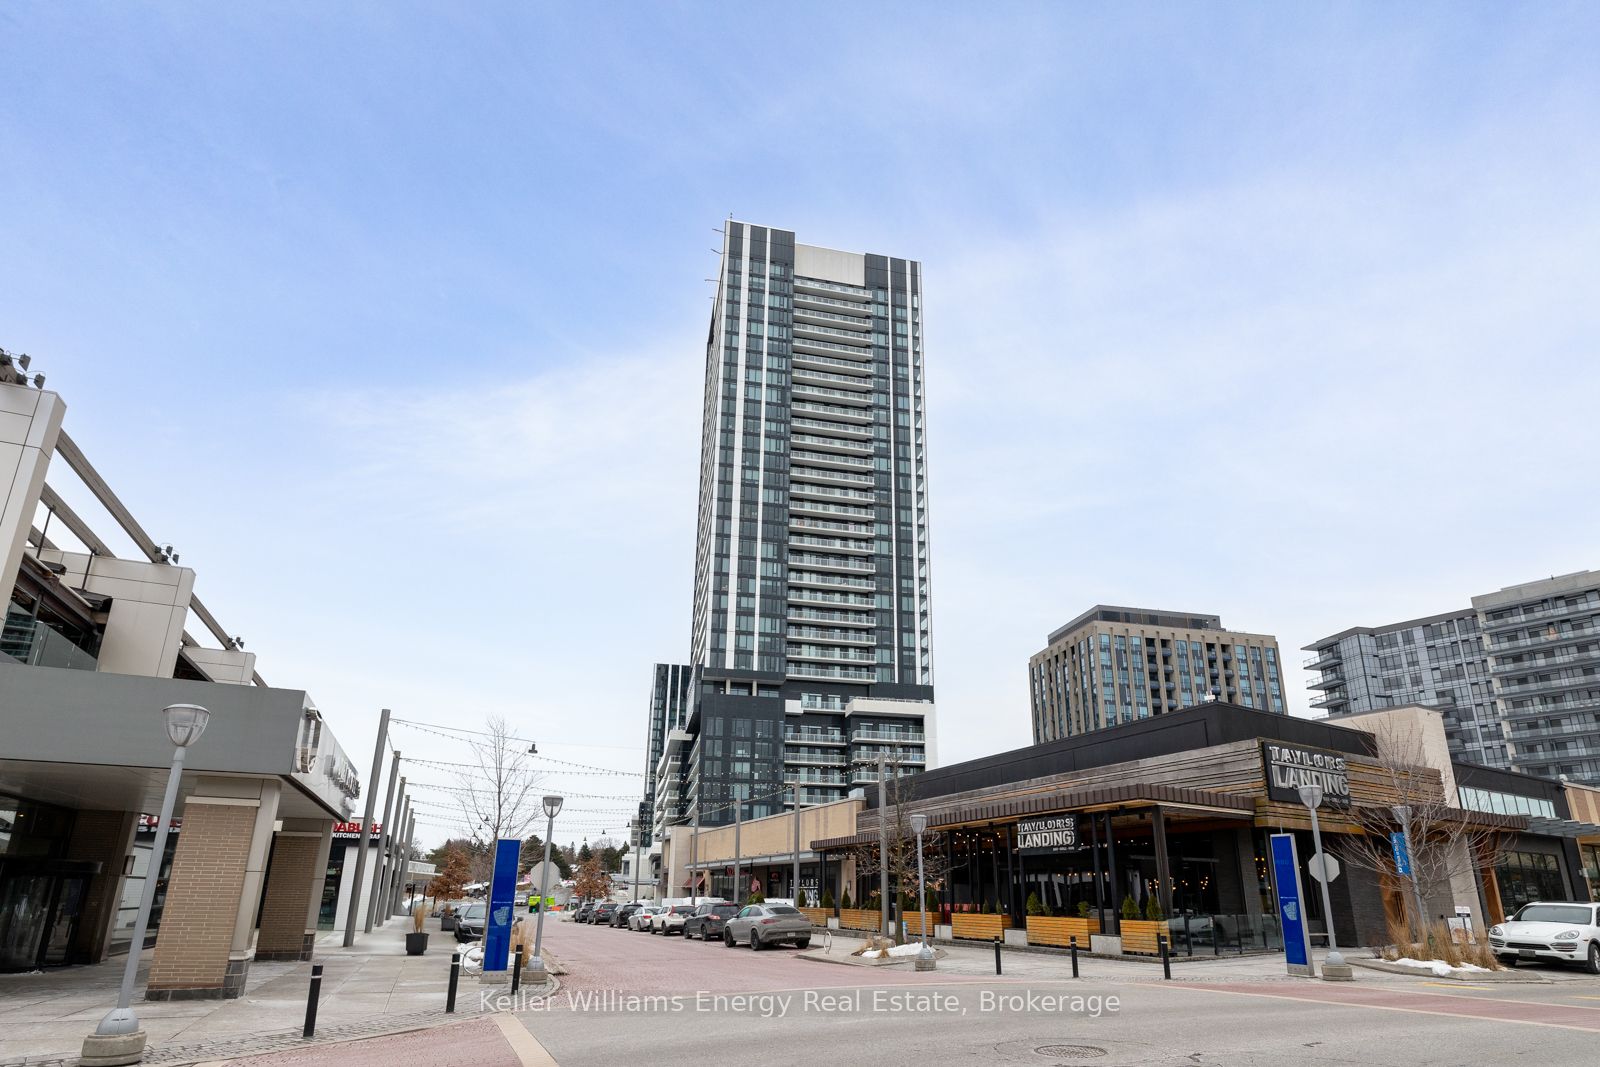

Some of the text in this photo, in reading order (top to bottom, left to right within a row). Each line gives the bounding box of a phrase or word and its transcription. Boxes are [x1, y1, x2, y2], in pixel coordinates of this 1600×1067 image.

[1268, 745, 1346, 770] TAYLORS
[1271, 764, 1350, 796] LANDING
[1016, 818, 1074, 832] TAYLORS
[1017, 830, 1075, 849] LANDING
[789, 878, 819, 887] TLORS
